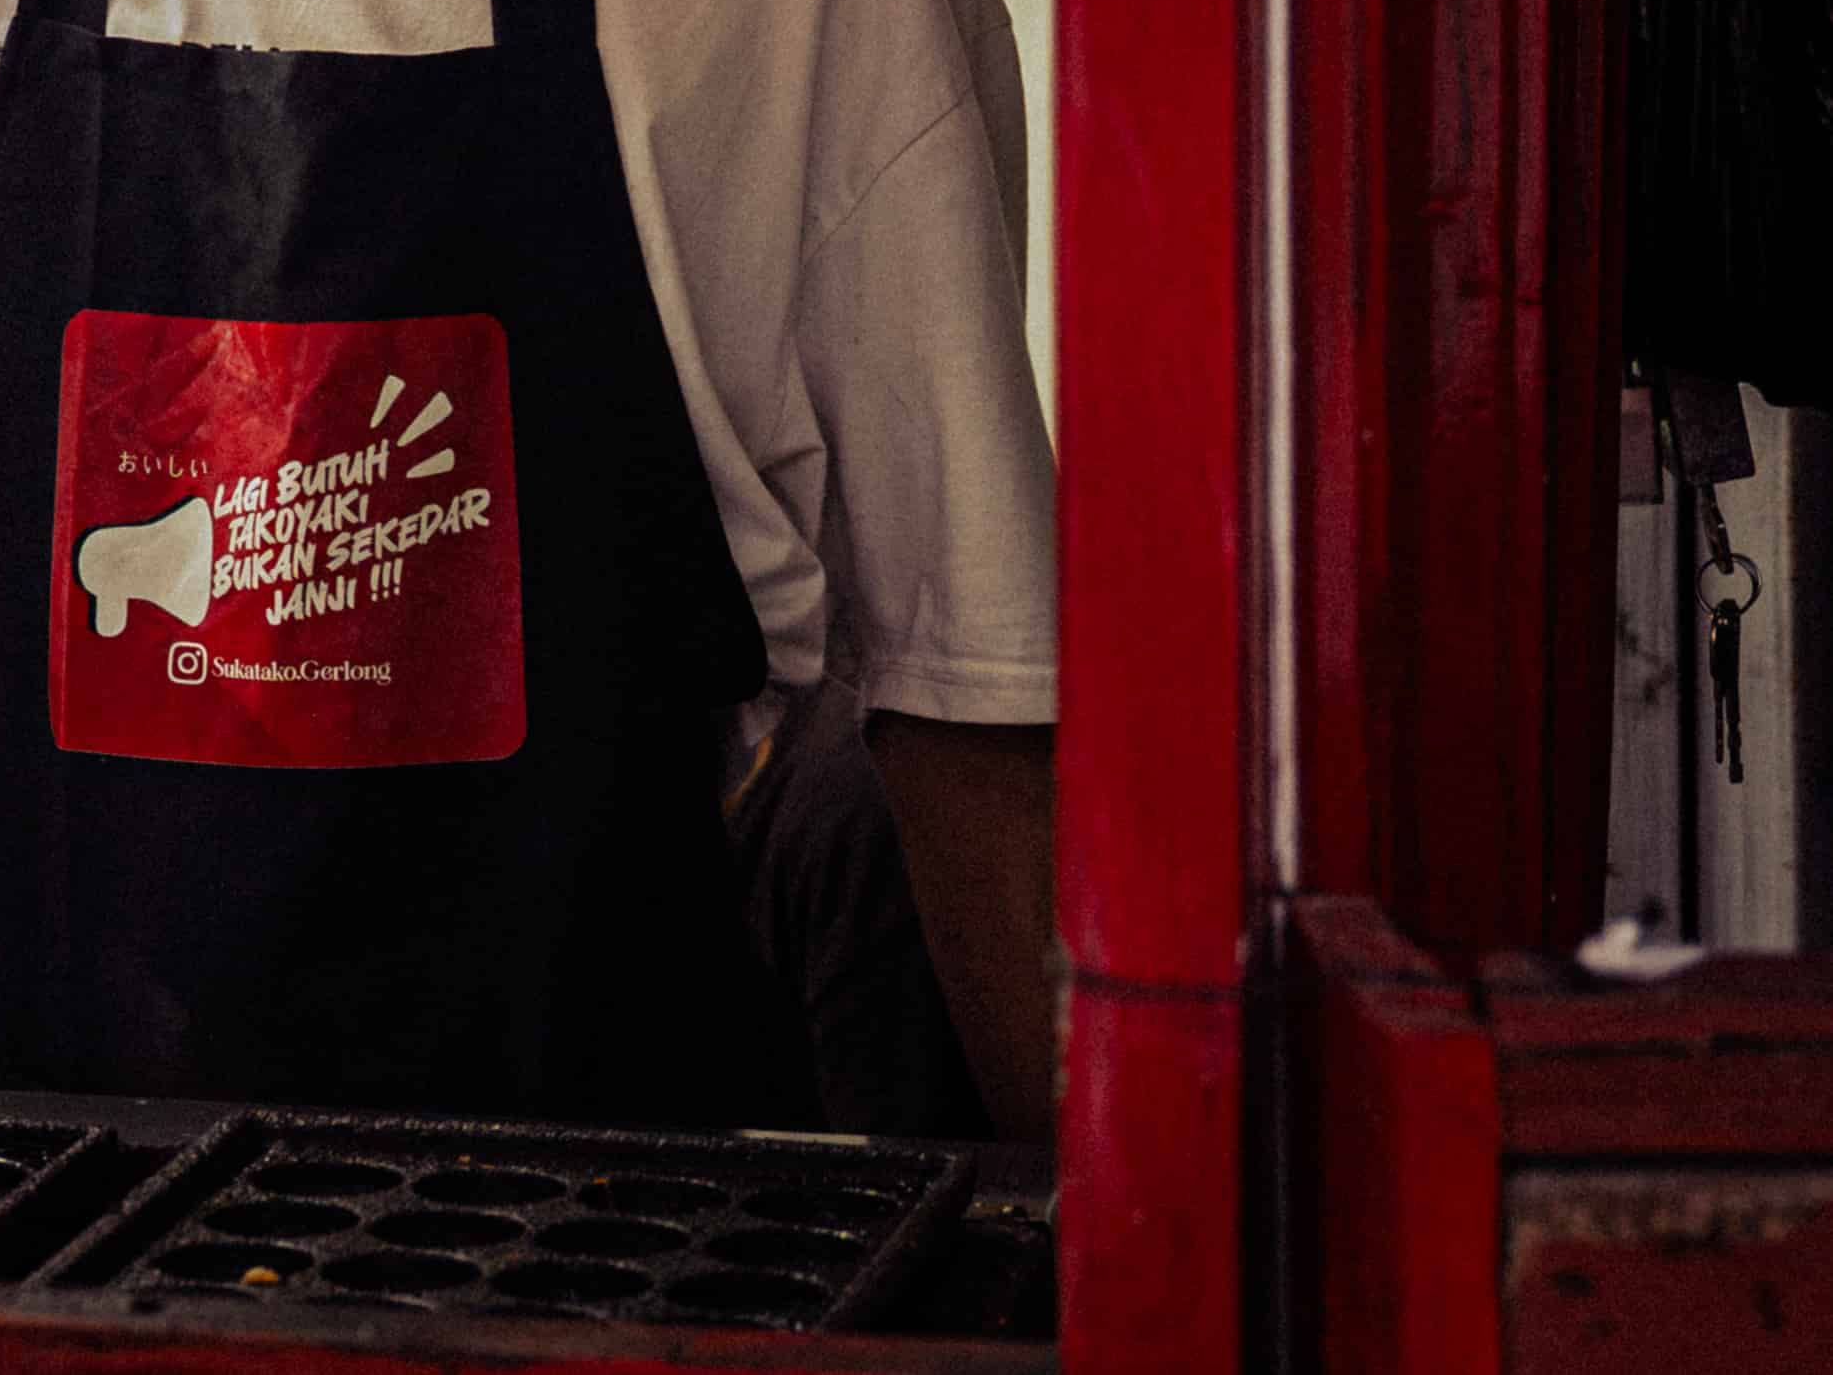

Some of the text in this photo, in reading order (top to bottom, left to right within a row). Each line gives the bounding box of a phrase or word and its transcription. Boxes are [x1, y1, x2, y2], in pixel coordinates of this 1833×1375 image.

[117, 451, 208, 479] おいしい
[213, 438, 389, 519] LAGI BUTUH
[212, 488, 491, 598] BUKAN SEKEDAR
[228, 490, 370, 552] TAKOYAKI
[265, 578, 357, 626] JANJI
[211, 656, 392, 684] Sukatako.Gerlong
